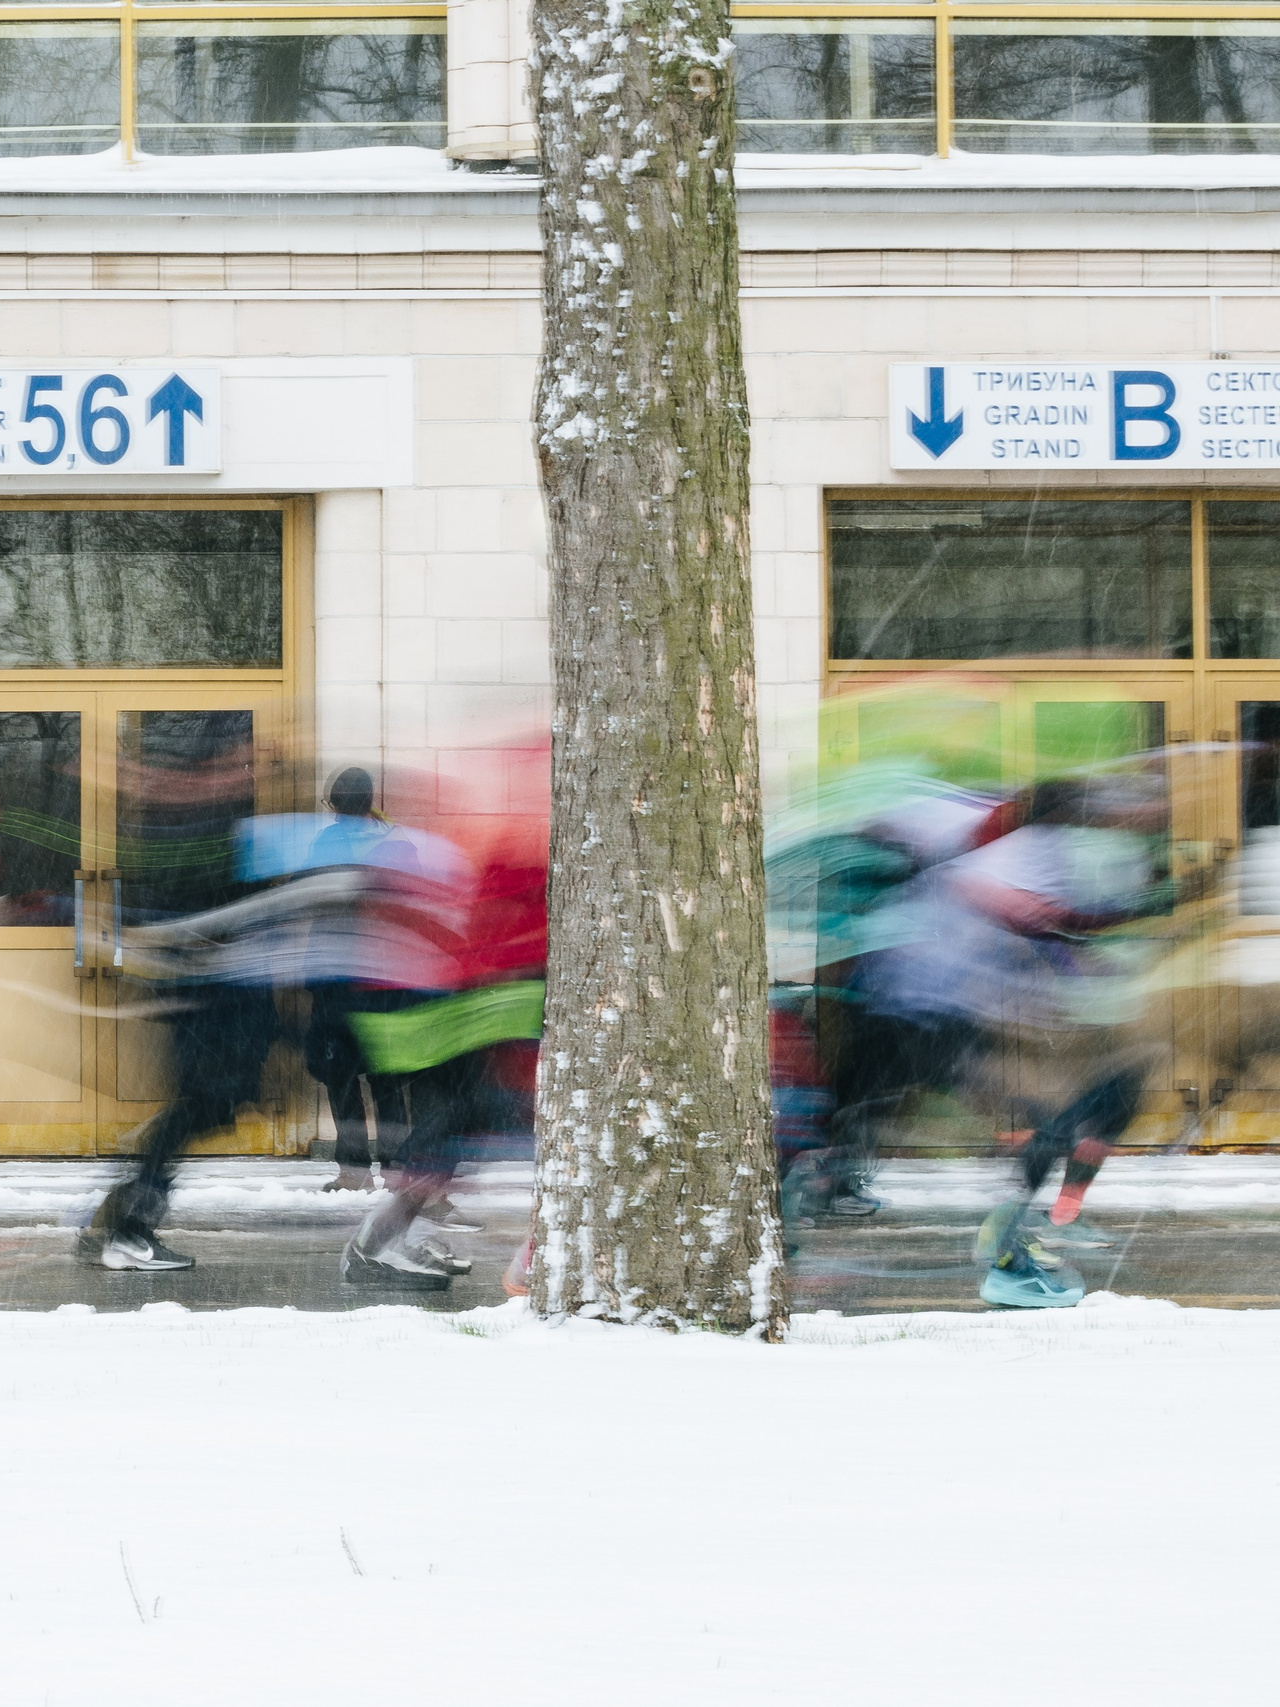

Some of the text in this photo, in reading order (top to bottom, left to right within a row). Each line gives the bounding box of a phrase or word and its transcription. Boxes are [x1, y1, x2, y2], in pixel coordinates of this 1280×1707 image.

[971, 371, 1097, 392] ТРИБУНА
[17, 373, 131, 471] 5,6
[983, 404, 1088, 426] GRADIN
[1199, 405, 1280, 425] SECTE
[991, 438, 1081, 460] STAND
[1201, 439, 1280, 459] SECTI
